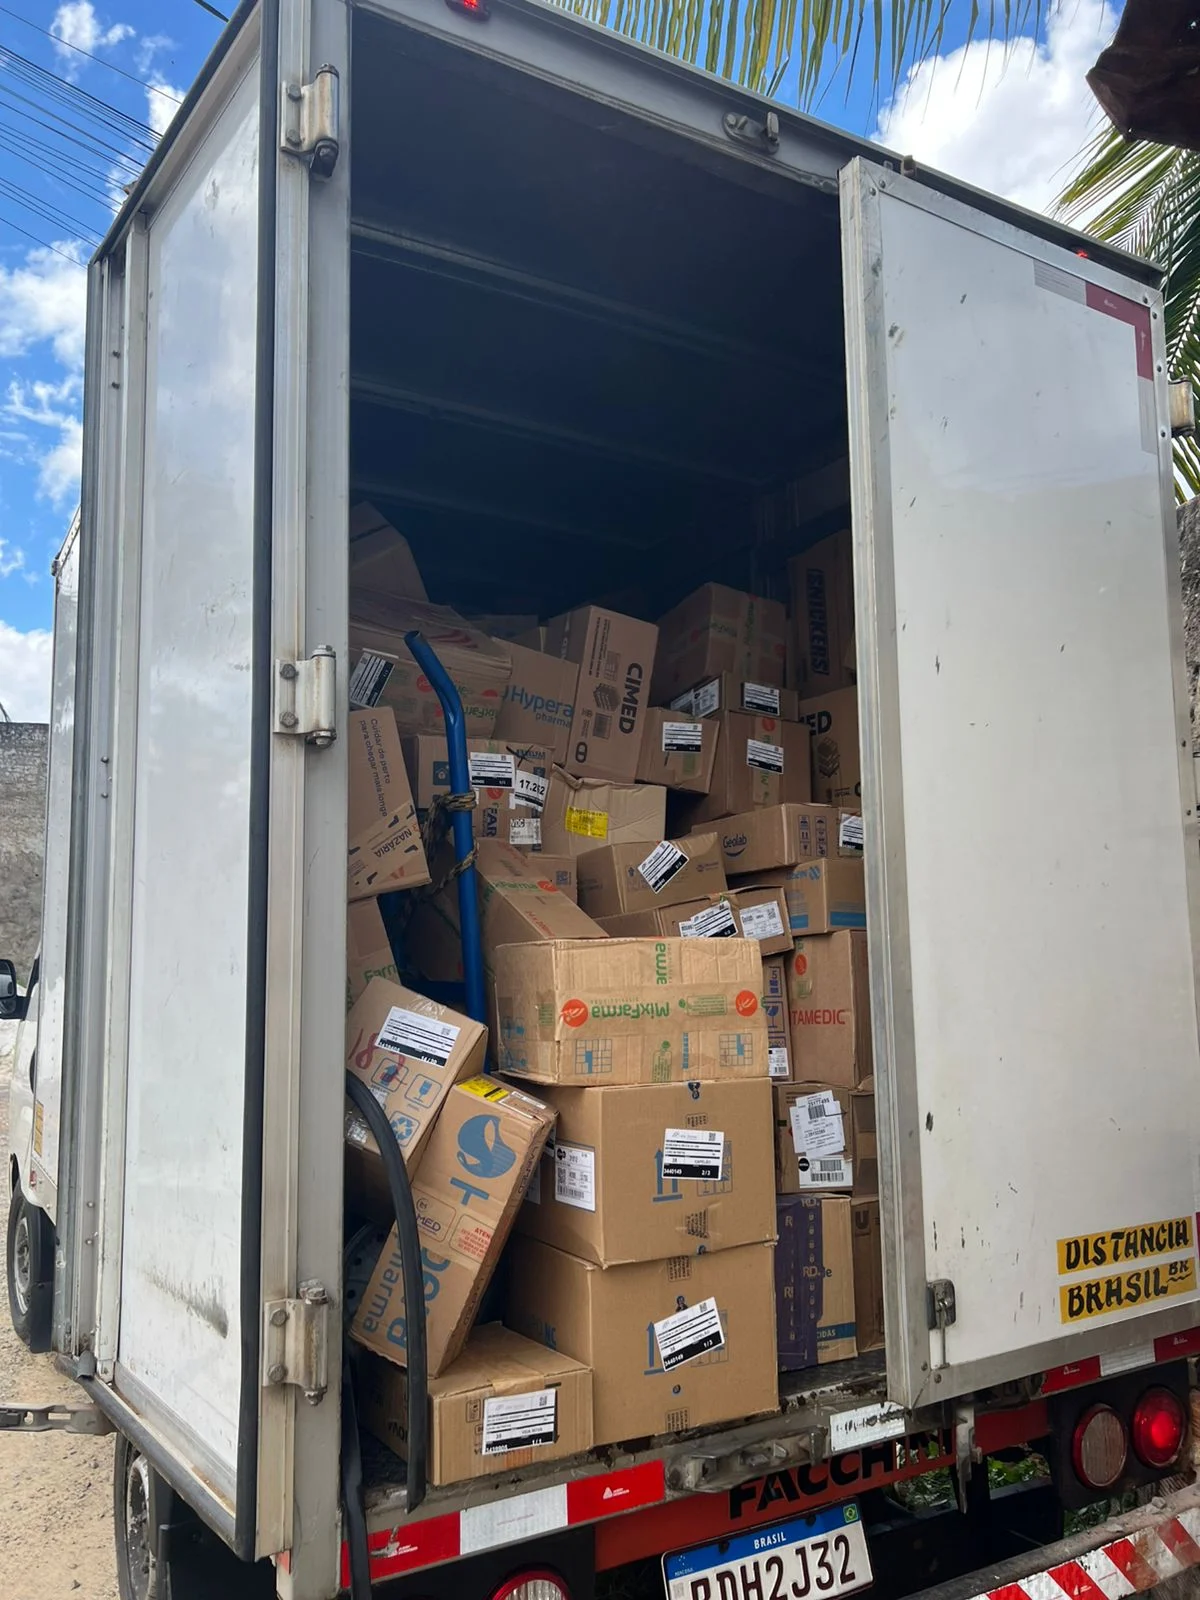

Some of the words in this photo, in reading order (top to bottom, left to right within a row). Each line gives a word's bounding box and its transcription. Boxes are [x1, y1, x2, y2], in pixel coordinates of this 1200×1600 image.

[808, 571, 830, 674] SNICKERS
[512, 686, 574, 717] Hypera
[618, 662, 643, 734] CIMED
[799, 710, 832, 735] ED
[591, 1001, 670, 1019] MixFarma
[792, 1009, 846, 1026] TAMEDIC
[1065, 1219, 1190, 1270] DISTANCIA
[1068, 1267, 1168, 1318] BRASIL
[754, 1531, 786, 1550] BRASIL
